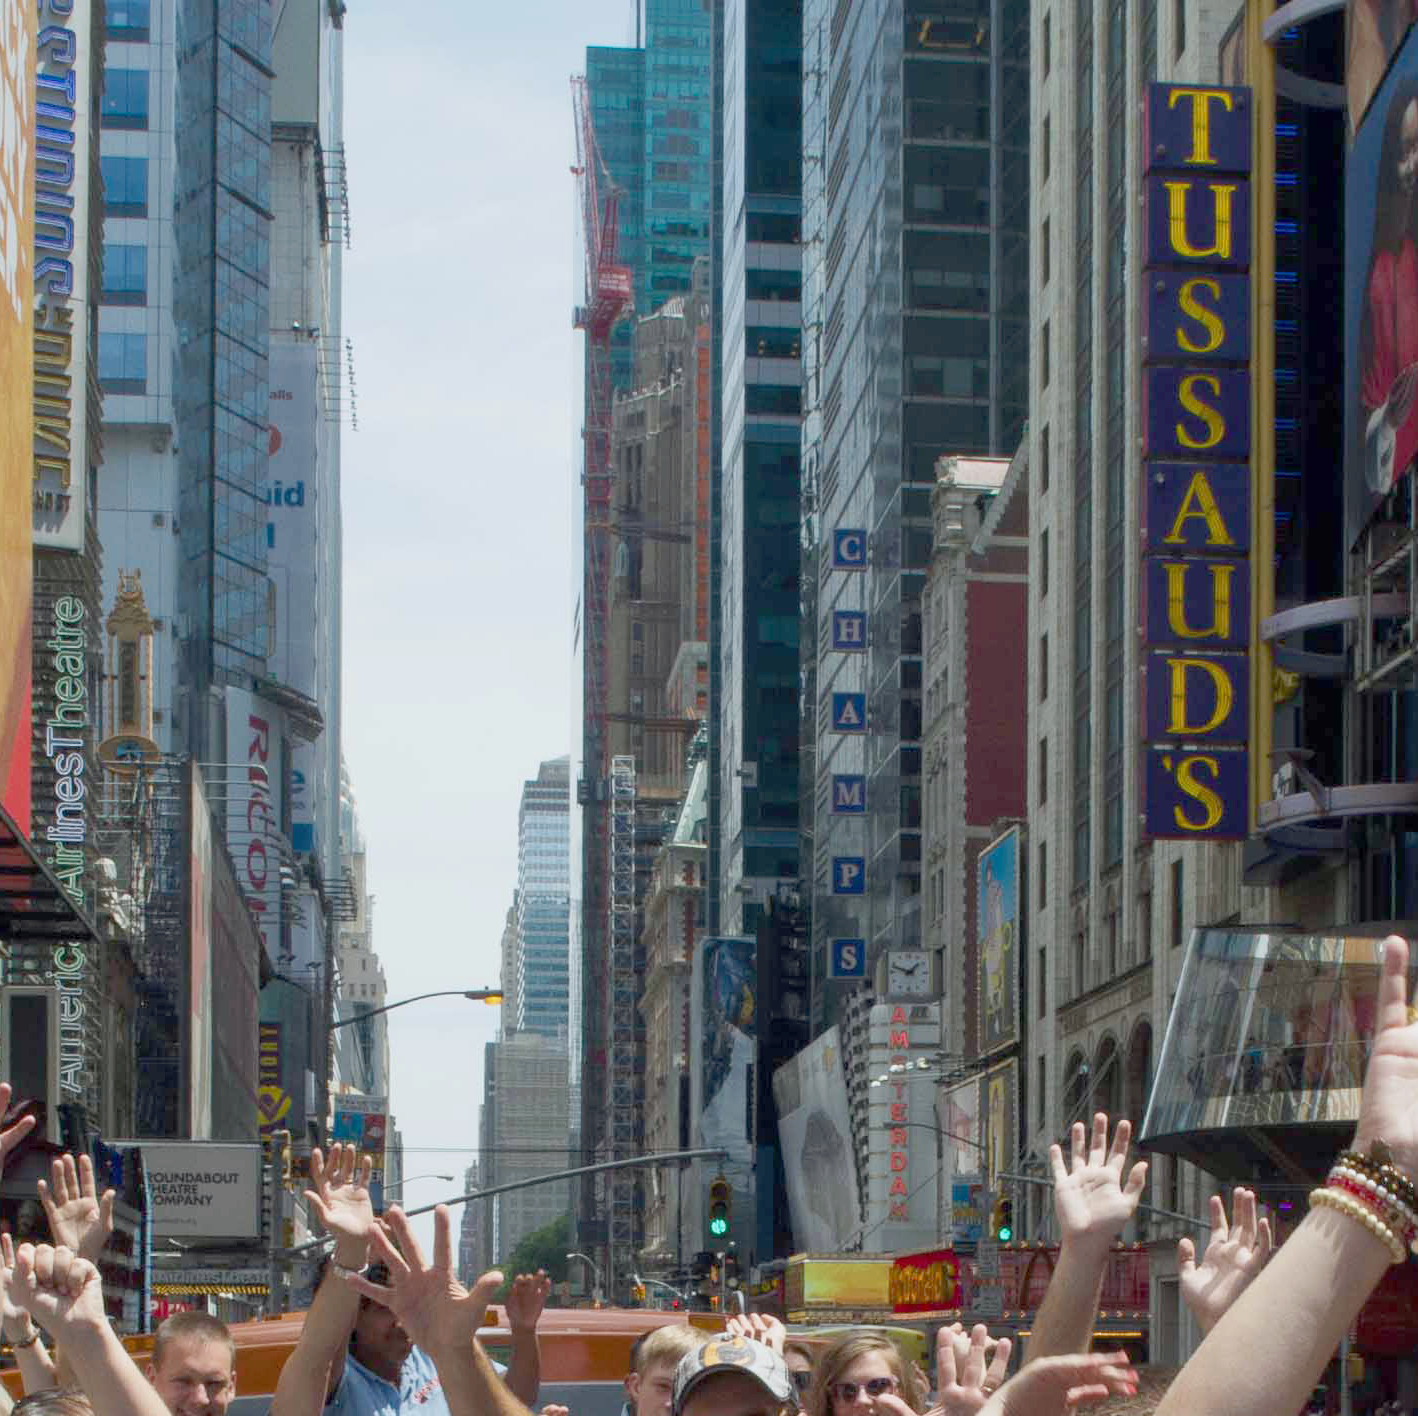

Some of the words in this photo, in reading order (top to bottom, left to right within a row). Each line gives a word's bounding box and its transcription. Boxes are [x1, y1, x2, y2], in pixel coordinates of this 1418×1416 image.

[1162, 88, 1237, 832] TUSSAUD'S
[837, 536, 864, 972] CHAMPS
[148, 1171, 240, 1185] ROUNDABOUT
[153, 1184, 199, 1195] HEATRE
